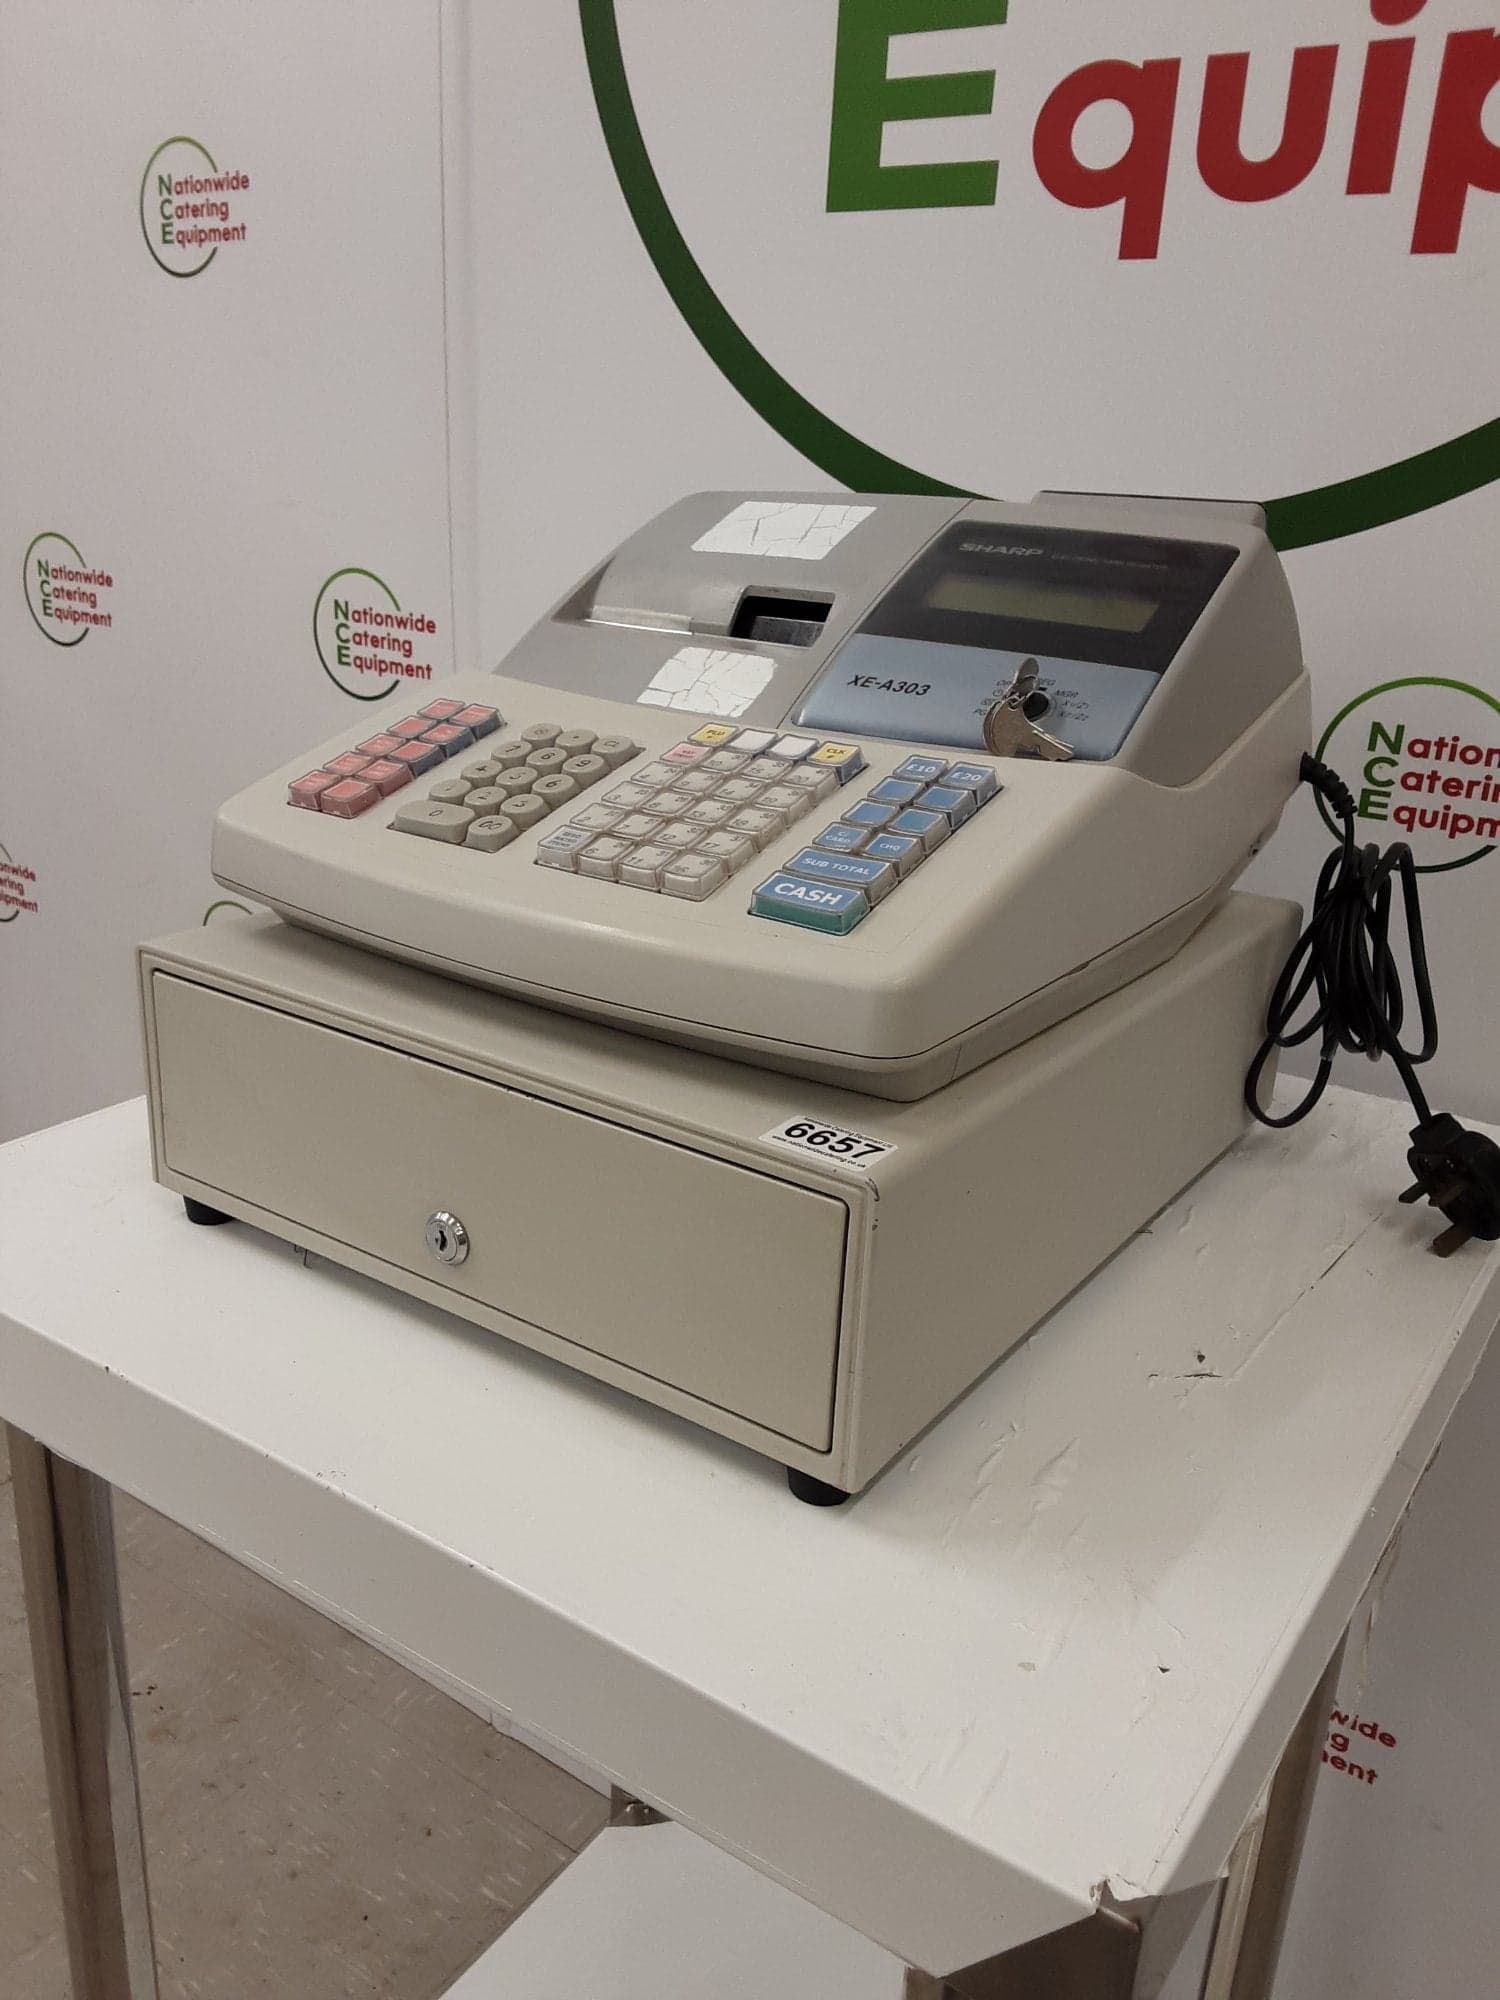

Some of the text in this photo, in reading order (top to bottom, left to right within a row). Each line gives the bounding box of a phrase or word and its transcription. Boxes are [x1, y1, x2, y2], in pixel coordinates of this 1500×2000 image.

[158, 170, 250, 197] Nationwide
[160, 198, 229, 222] Catering
[161, 222, 246, 249] Equipment
[959, 543, 1043, 557] SHARP
[37, 559, 113, 588] Nationwide
[40, 580, 97, 609] Catering
[42, 599, 112, 627] Equipment
[334, 599, 437, 634] Nationwide
[335, 622, 413, 658] Catering
[337, 645, 433, 680] Equipment
[847, 674, 931, 696] XE-A303
[1367, 721, 1500, 769] Nation
[905, 763, 937, 774] £10
[950, 771, 981, 782] £20
[1357, 788, 1500, 839] Equipm
[802, 856, 870, 876] SUB TOTAL
[774, 882, 843, 906] CASH
[784, 1122, 886, 1159] 6657
